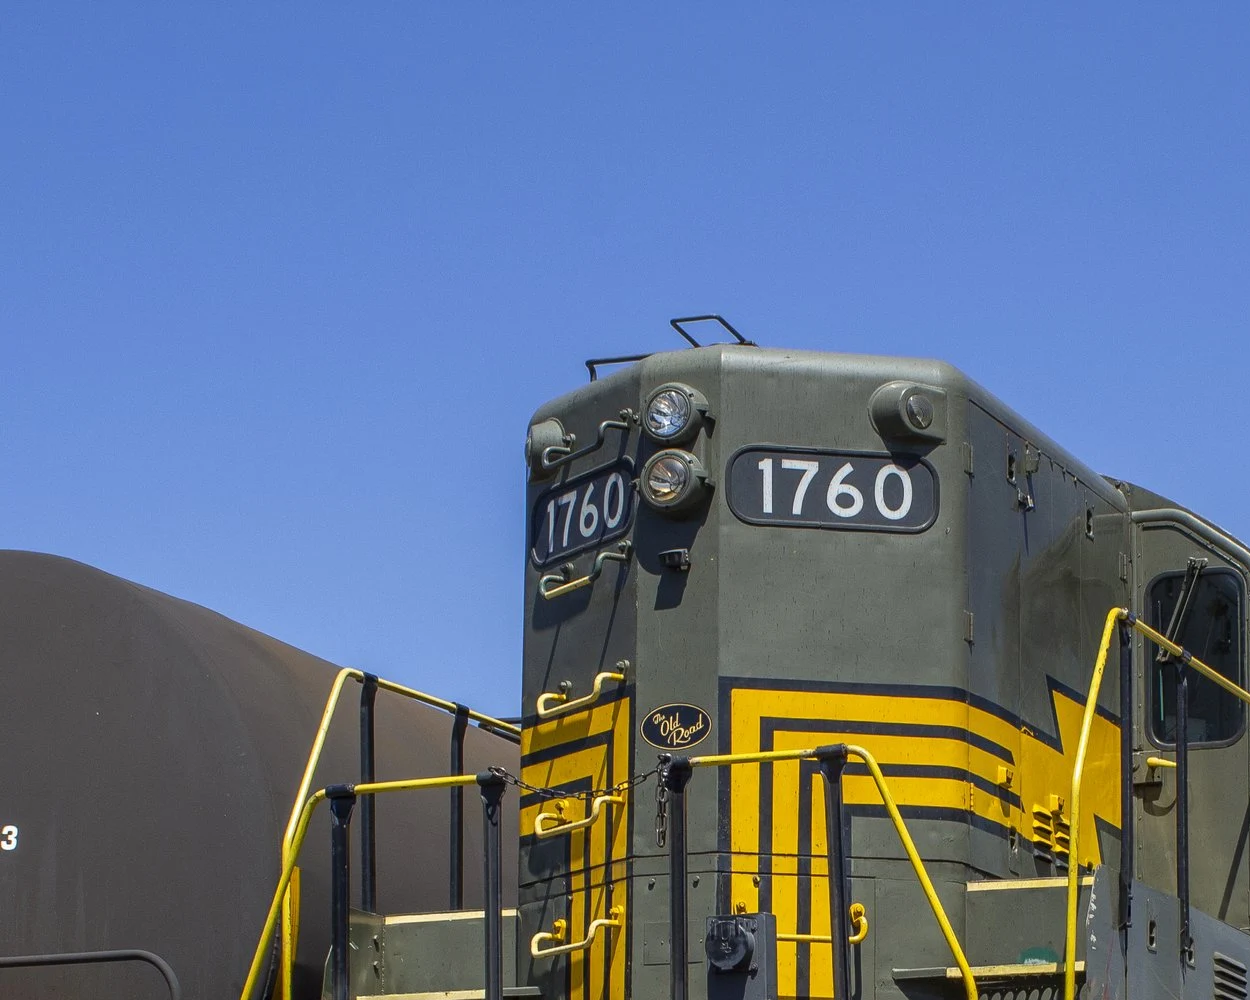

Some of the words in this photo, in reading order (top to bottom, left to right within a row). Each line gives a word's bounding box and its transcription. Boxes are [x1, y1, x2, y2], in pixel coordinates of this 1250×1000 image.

[757, 457, 914, 521] 1760
[546, 471, 624, 554] 1760
[660, 711, 681, 737] Old
[667, 713, 705, 746] Road
[0, 825, 19, 851] 3
